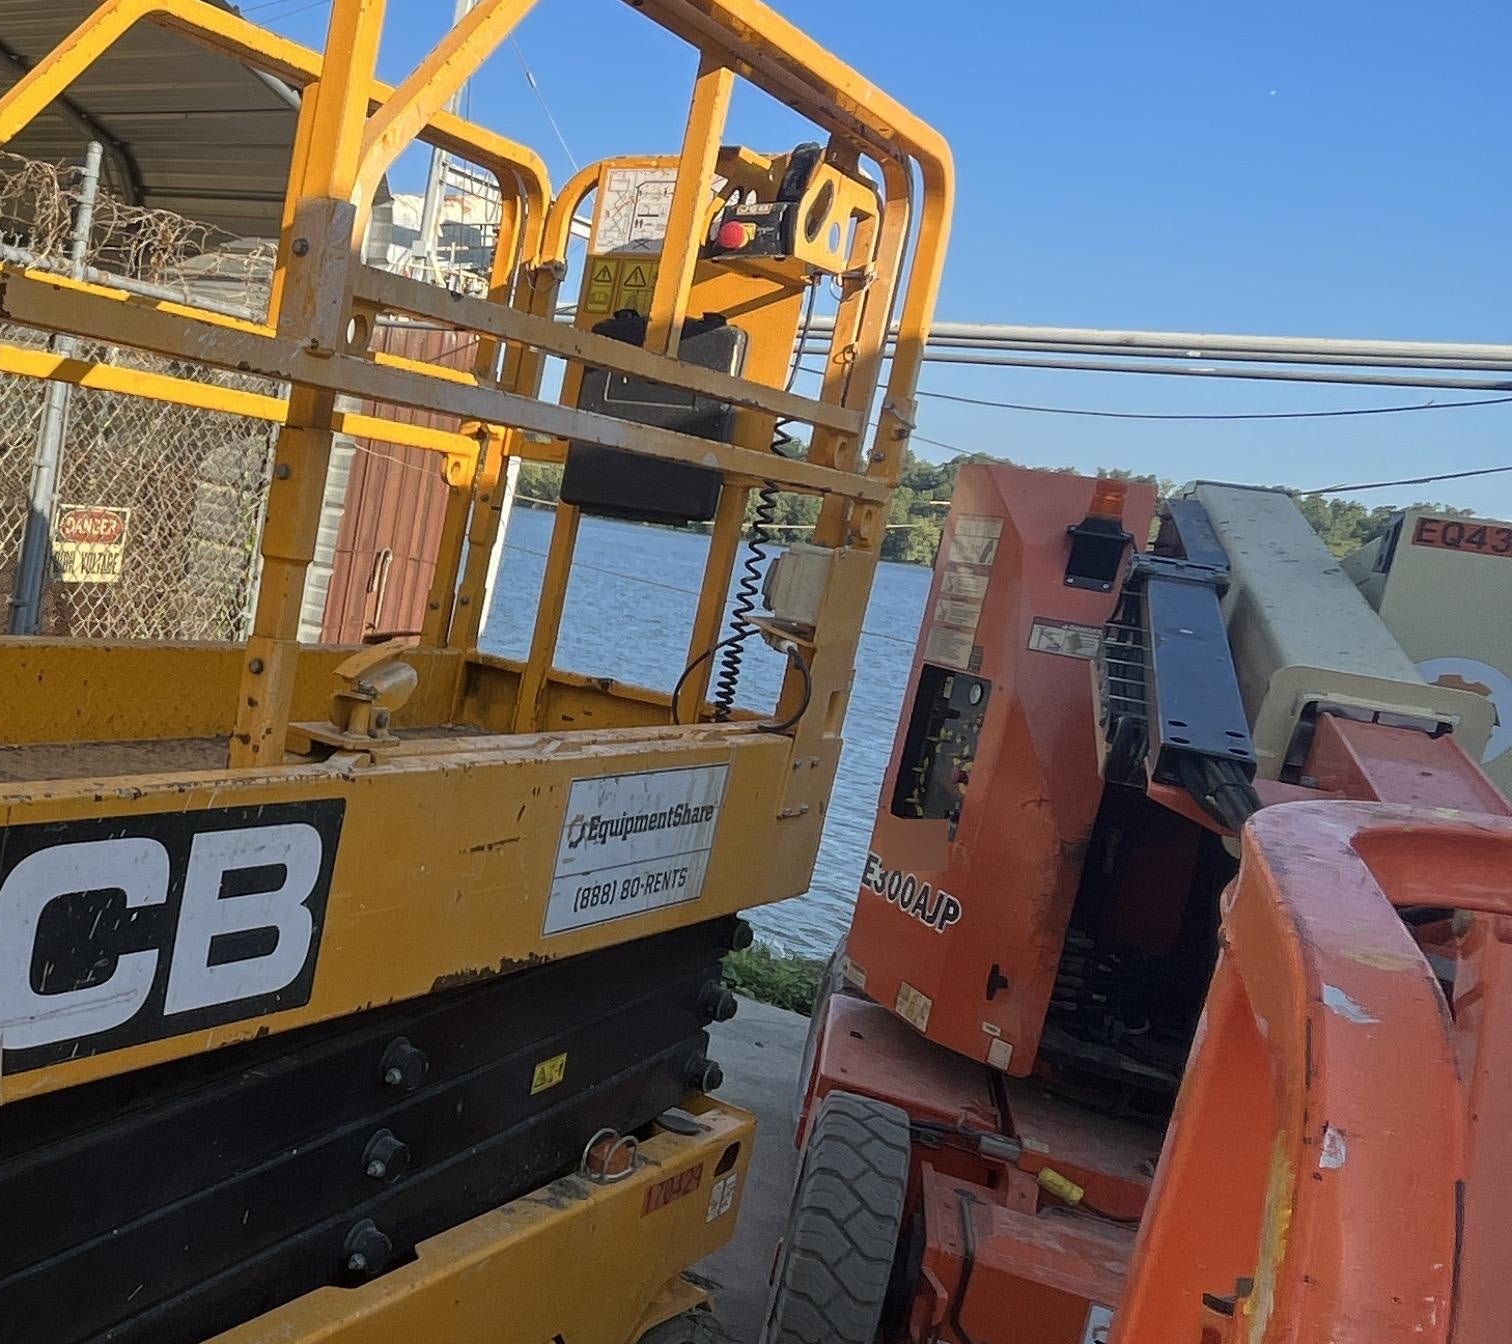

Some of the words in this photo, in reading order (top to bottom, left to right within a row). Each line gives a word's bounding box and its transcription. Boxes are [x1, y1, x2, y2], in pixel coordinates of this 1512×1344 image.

[64, 516, 118, 536] DANGER
[587, 803, 716, 846] EquipmentShare
[573, 880, 618, 913] (888)
[620, 867, 689, 900] 80-RENTS
